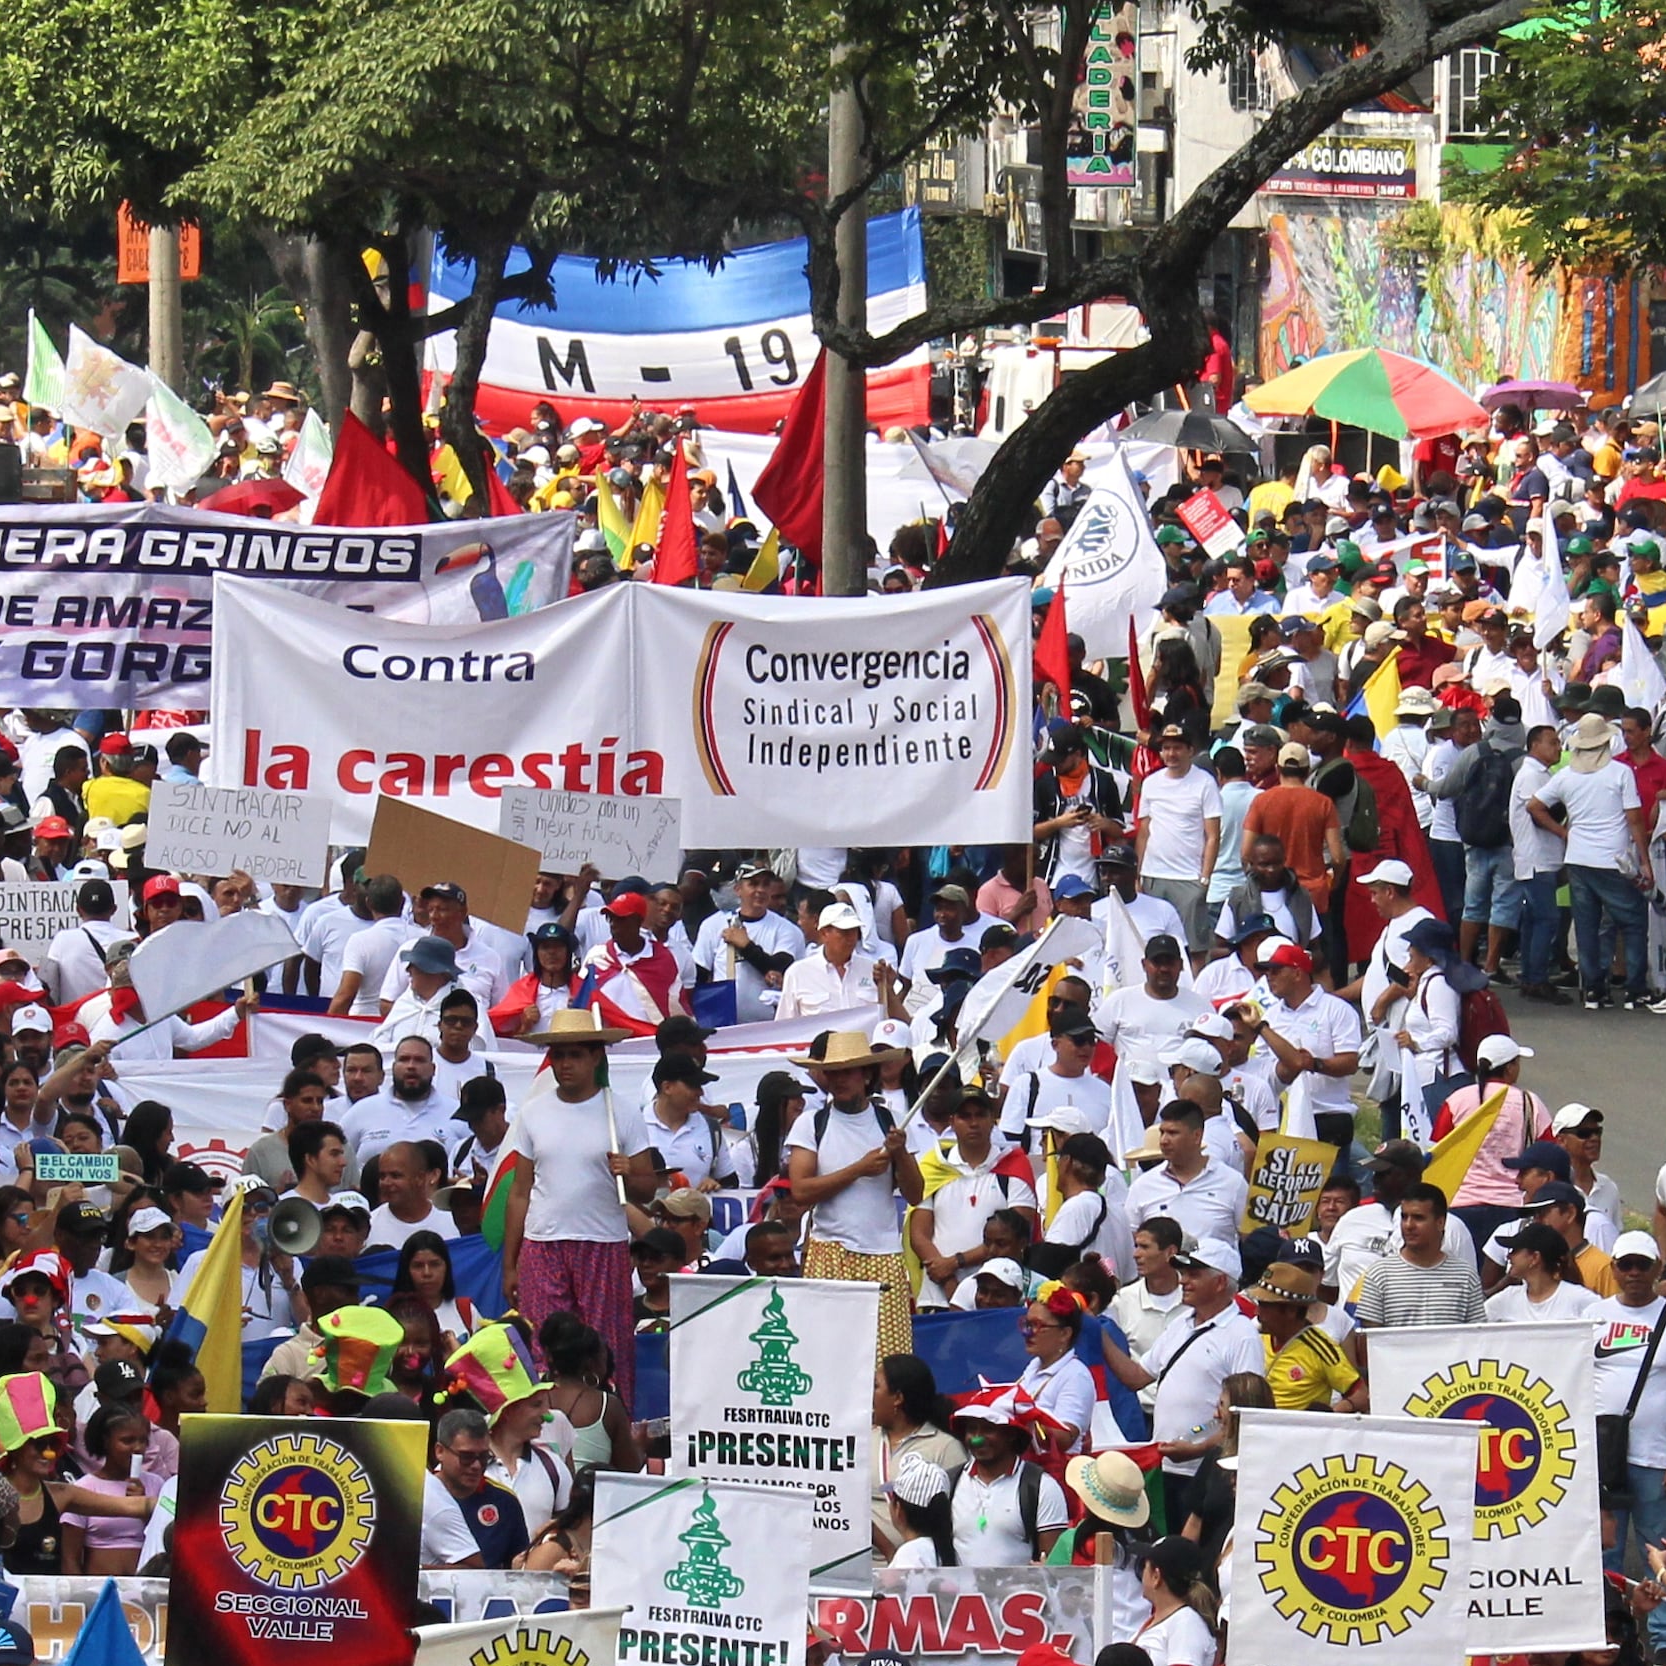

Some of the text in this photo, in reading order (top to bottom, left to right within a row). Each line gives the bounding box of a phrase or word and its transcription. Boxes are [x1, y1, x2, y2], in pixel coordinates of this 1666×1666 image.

[1311, 148, 1405, 175] COLOMBIANO
[537, 336, 595, 393] M
[725, 328, 798, 391] 19
[138, 529, 416, 574] GRINGOS
[342, 645, 535, 682] Contra
[746, 640, 970, 688] Convergencia
[743, 694, 978, 728] Sindical y Social
[244, 729, 664, 797] la carestía
[748, 733, 972, 772] Independiente
[171, 784, 303, 822] SINTRACAR
[166, 815, 280, 844] DICE NO AL
[160, 847, 218, 869] ACOSO
[40, 1168, 112, 1180] ES CON VOS
[67, 1155, 114, 1166] CAMBIO
[1297, 1164, 1305, 1175] A
[1307, 1162, 1323, 1175] LA
[1258, 1168, 1324, 1190] REFORMA
[1254, 1196, 1312, 1226] SALUD
[1274, 1190, 1299, 1204] A LA
[724, 1407, 830, 1428] FESRTRALVA CTC
[688, 1430, 856, 1472] ¡PRESENTE!
[255, 1493, 339, 1532] CTC
[1299, 1525, 1407, 1576] CTC
[214, 1591, 368, 1619] SECCIONAL
[648, 1606, 763, 1632] FESRTRALVA CTC
[247, 1617, 334, 1640] VALLE
